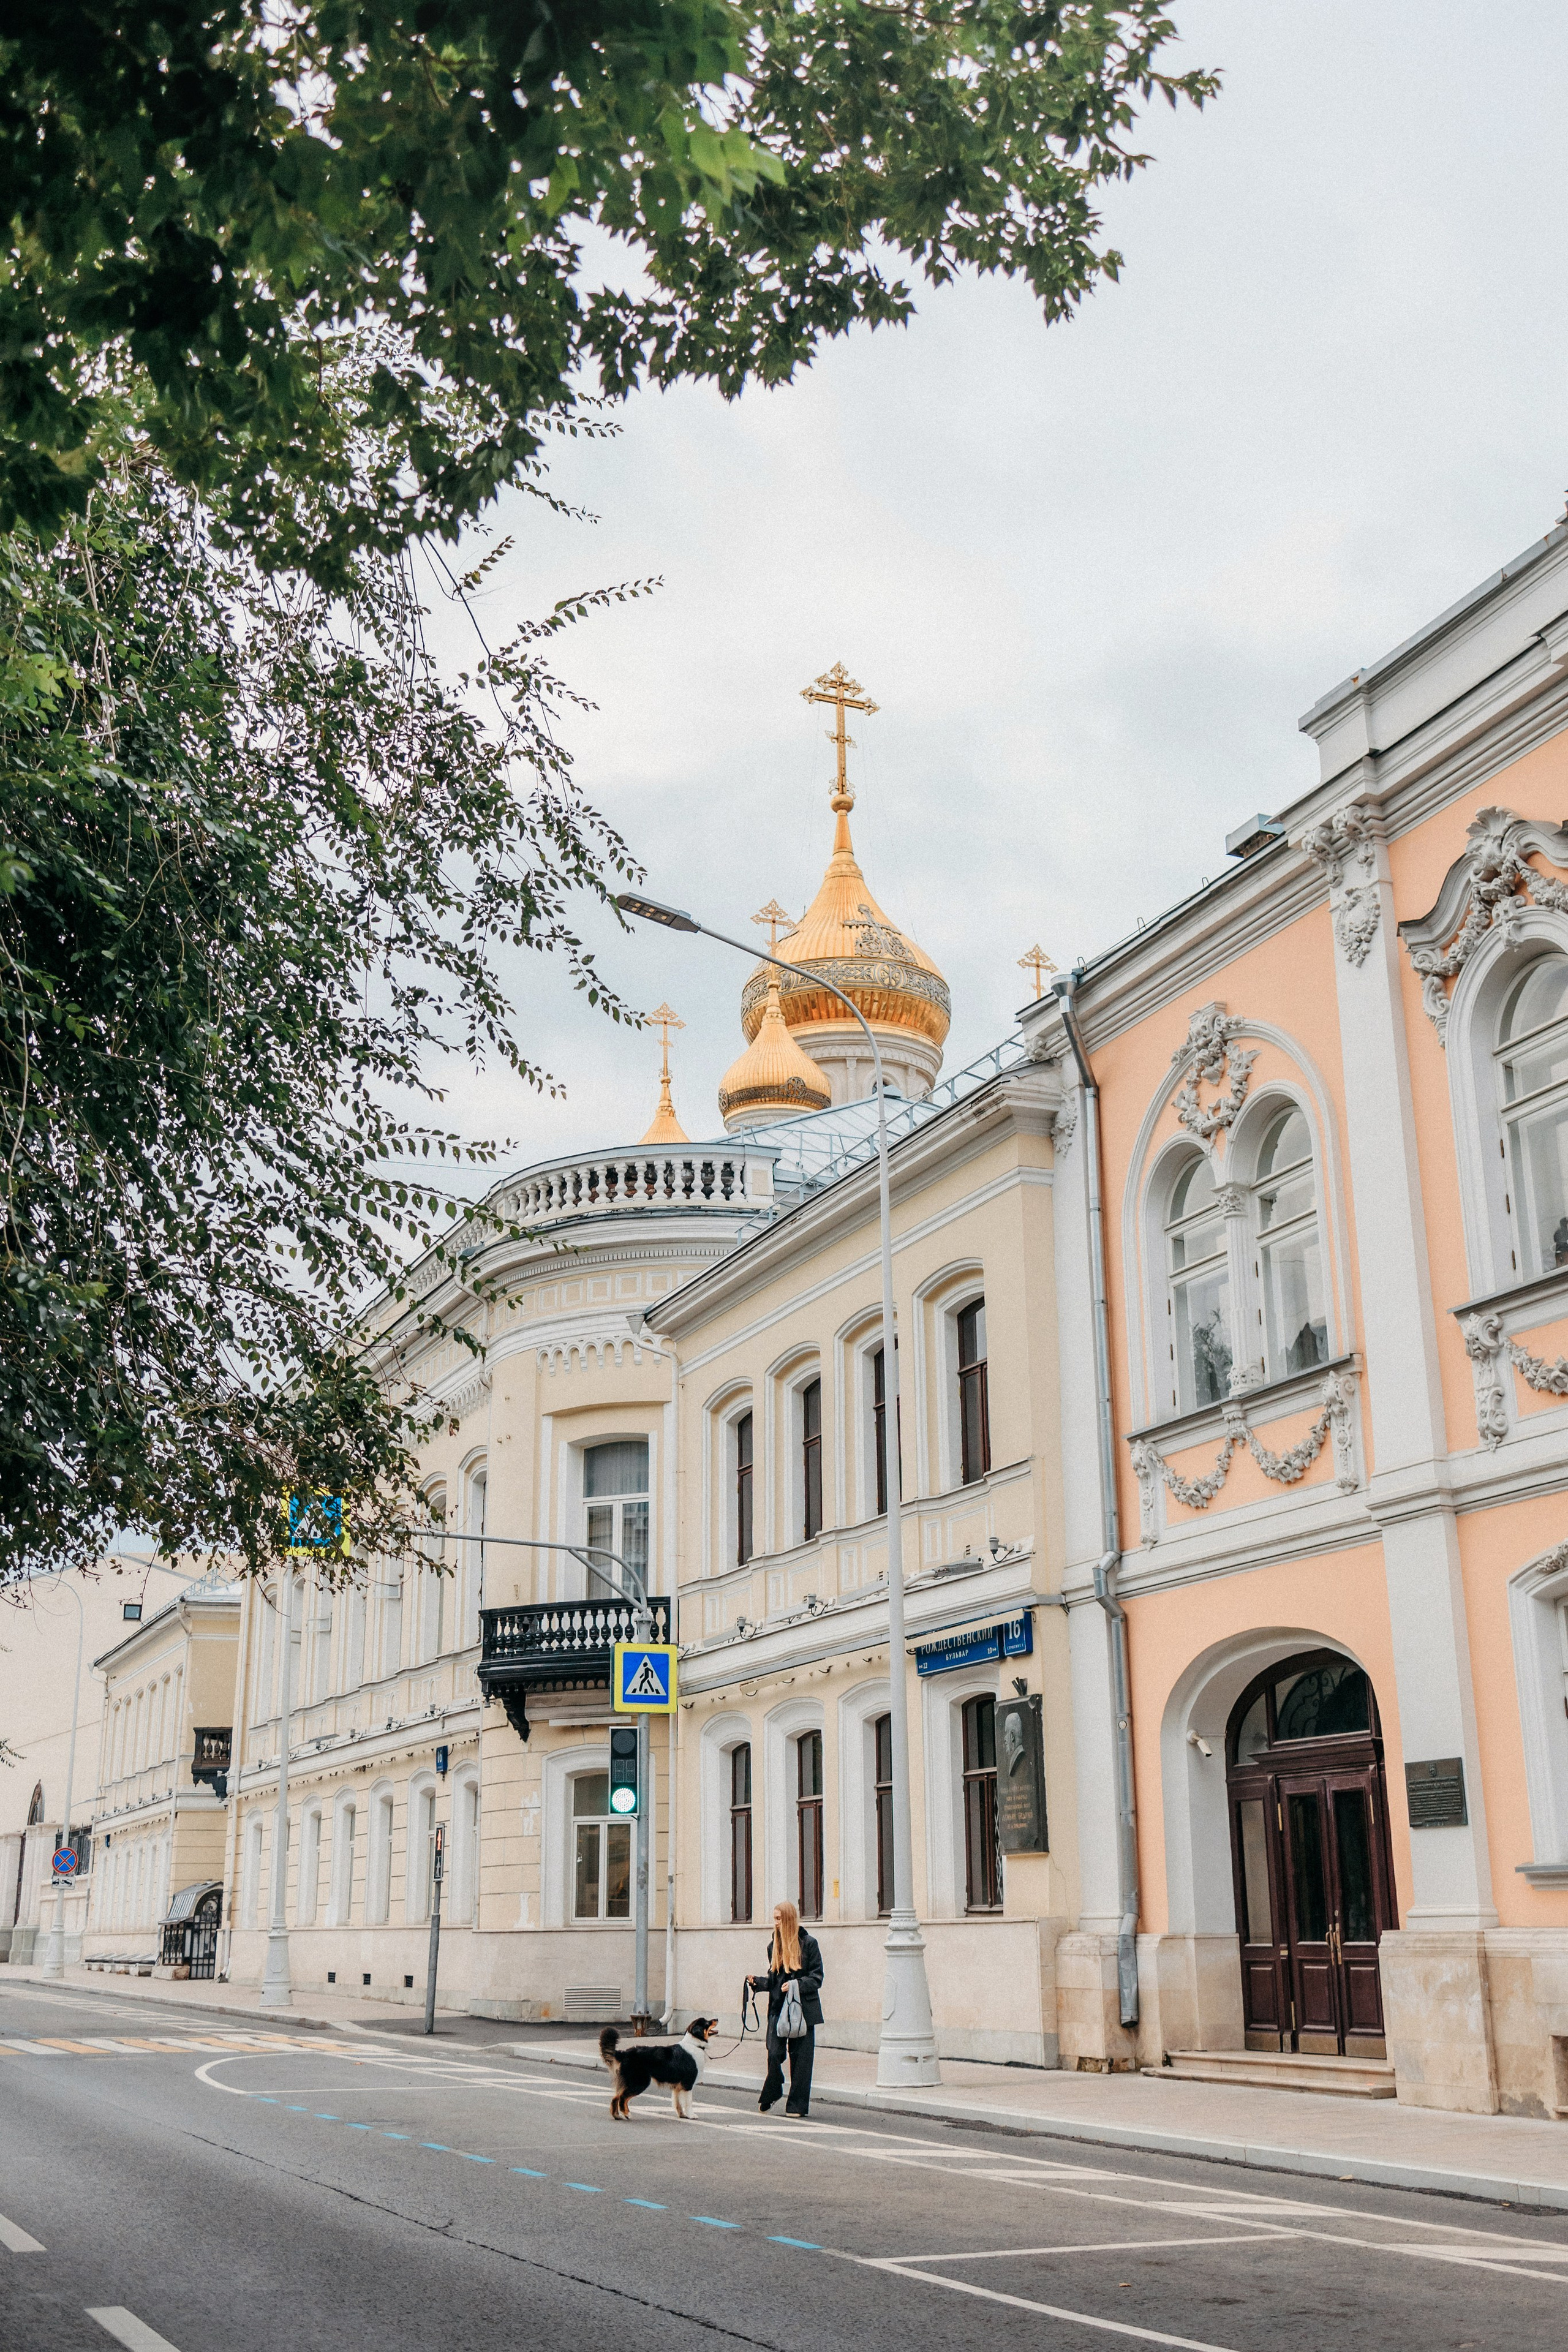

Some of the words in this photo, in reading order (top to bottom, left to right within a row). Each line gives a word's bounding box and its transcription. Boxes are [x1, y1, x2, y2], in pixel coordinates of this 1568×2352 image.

[1008, 1619, 1020, 1640] 16
[946, 1649, 968, 1661] БУЛЬВАР
[437, 1750, 442, 1763] 16
